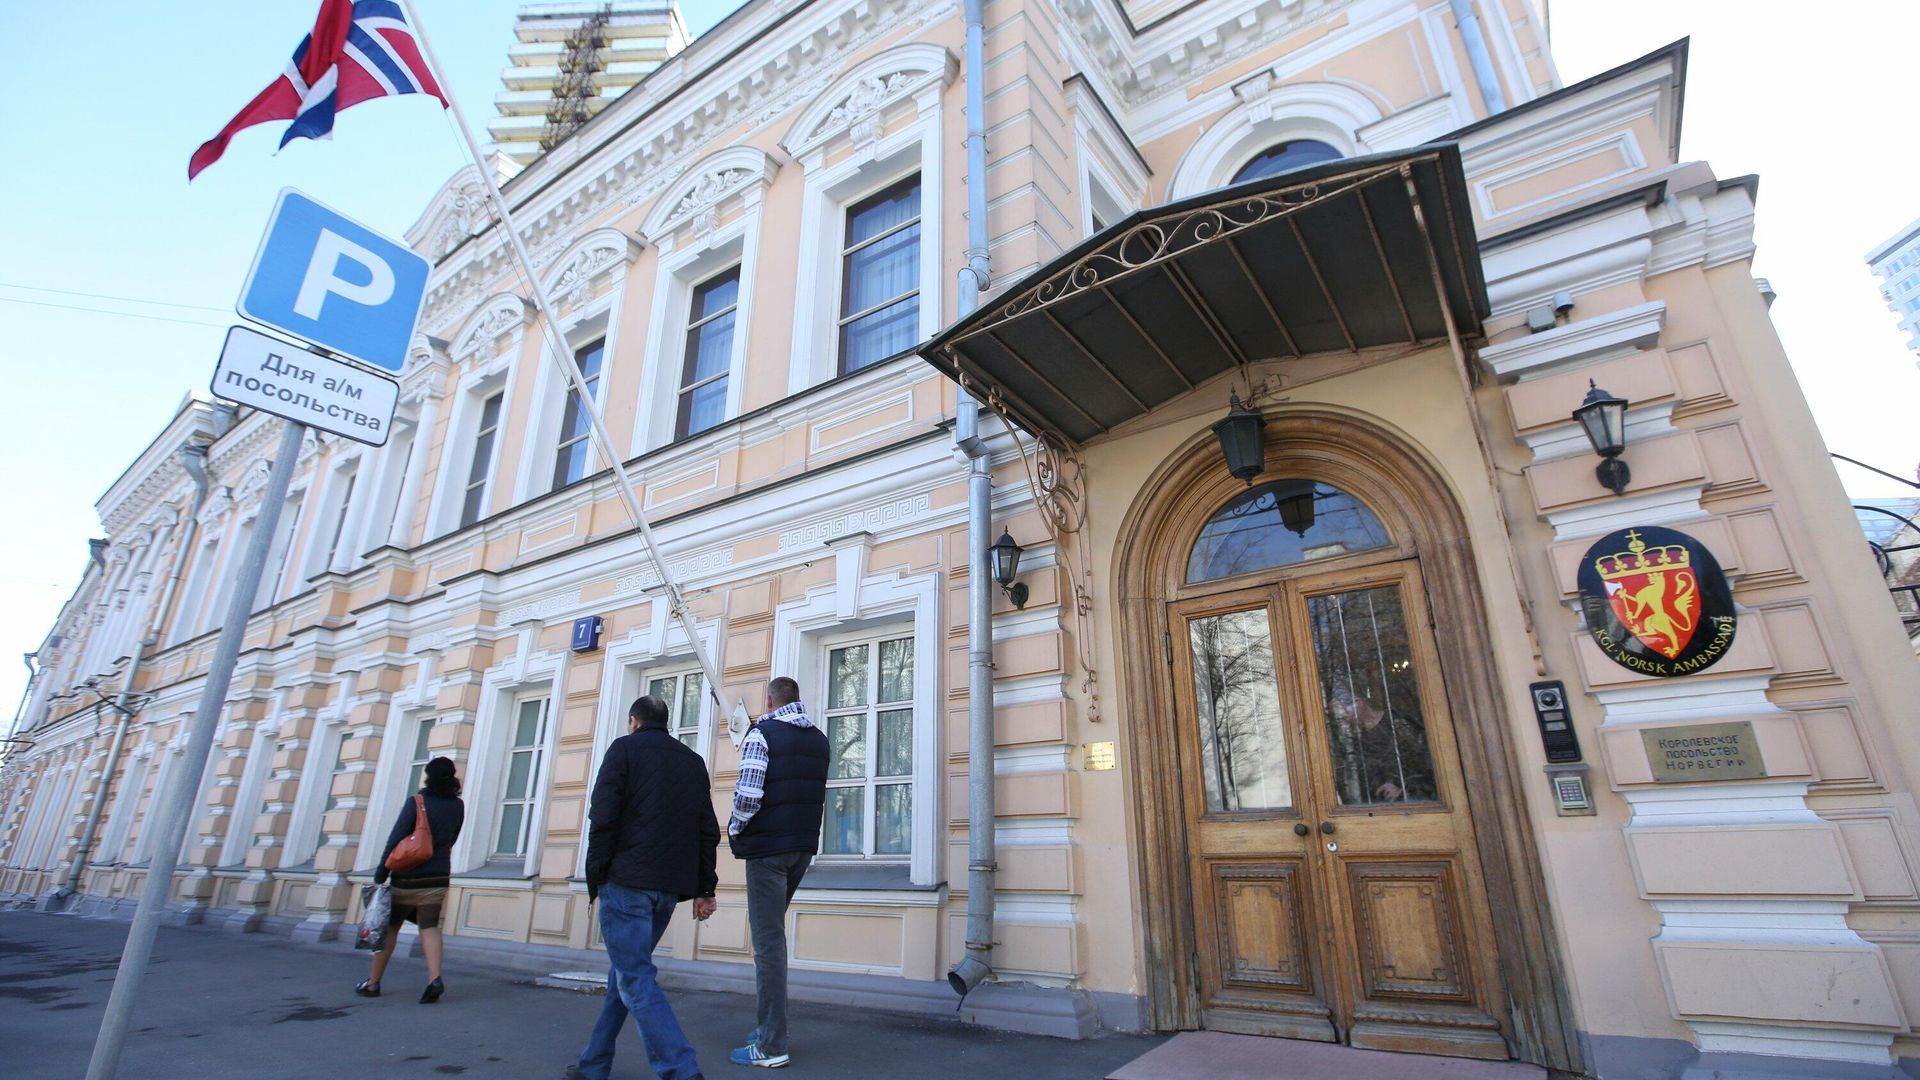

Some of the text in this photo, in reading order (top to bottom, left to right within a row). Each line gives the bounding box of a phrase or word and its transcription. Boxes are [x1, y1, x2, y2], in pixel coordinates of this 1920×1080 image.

[293, 227, 396, 321] P
[226, 370, 382, 431] посольства
[260, 352, 363, 400] Для а/м
[579, 623, 586, 639] 7
[1618, 650, 1667, 674] NORSK
[1673, 615, 1733, 673] AMBASSADE
